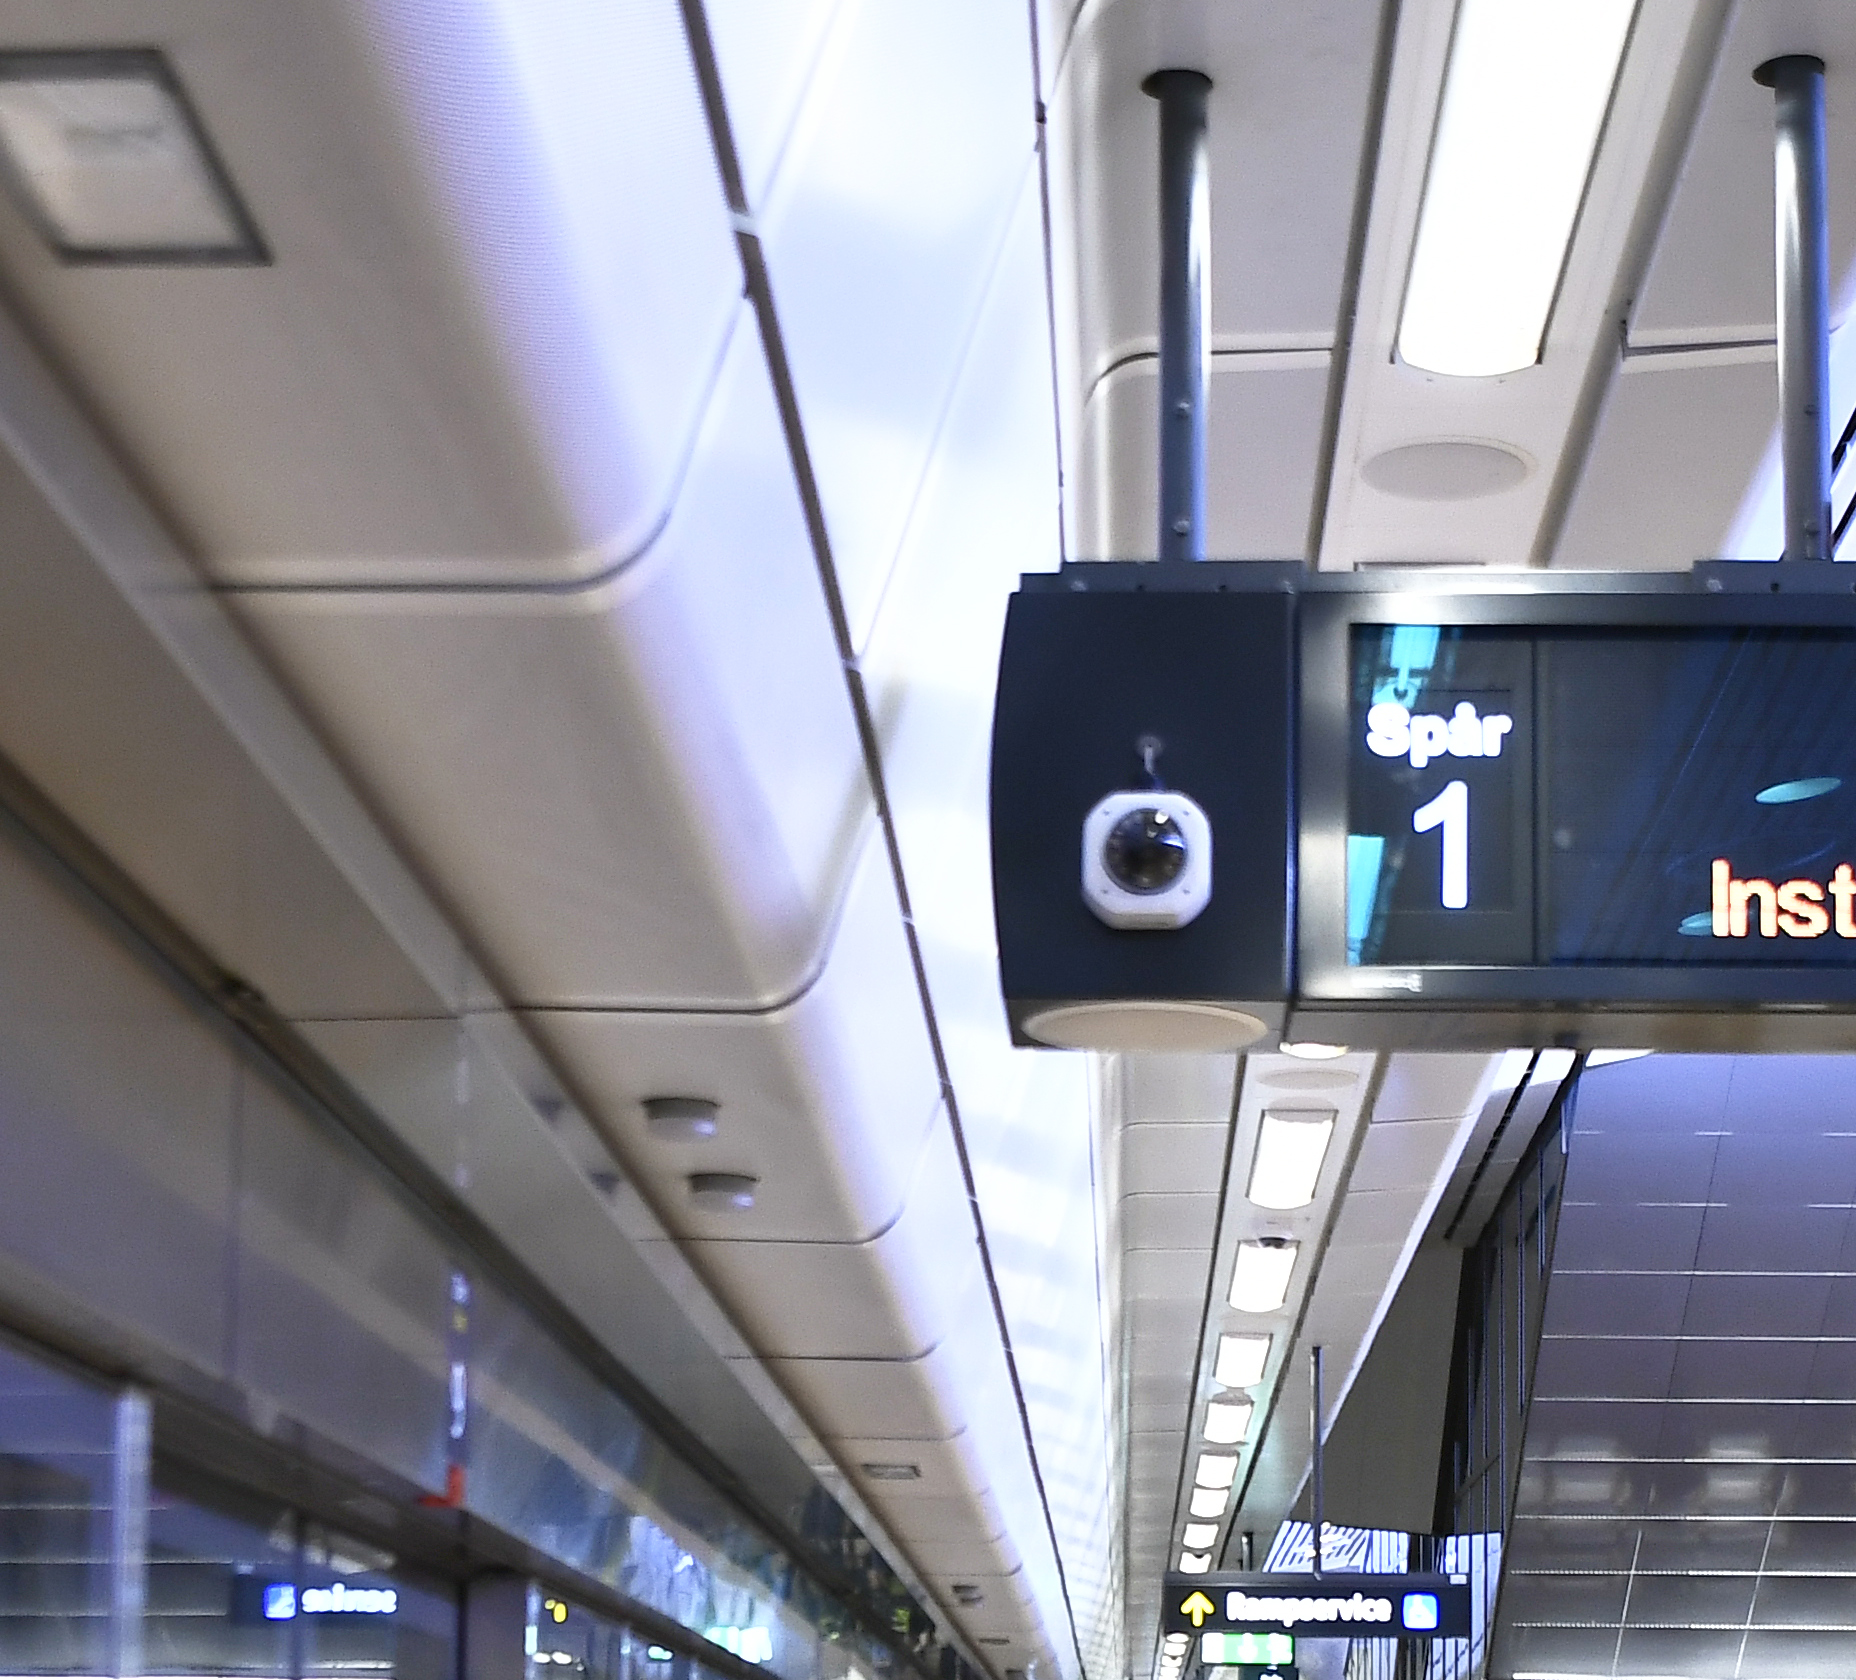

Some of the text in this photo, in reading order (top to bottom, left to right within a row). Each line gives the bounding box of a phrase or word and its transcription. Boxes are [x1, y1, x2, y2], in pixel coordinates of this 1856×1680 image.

[1366, 701, 1513, 768] Spår
[1413, 780, 1469, 909] 1
[1225, 1590, 1393, 1627] Rampservice
